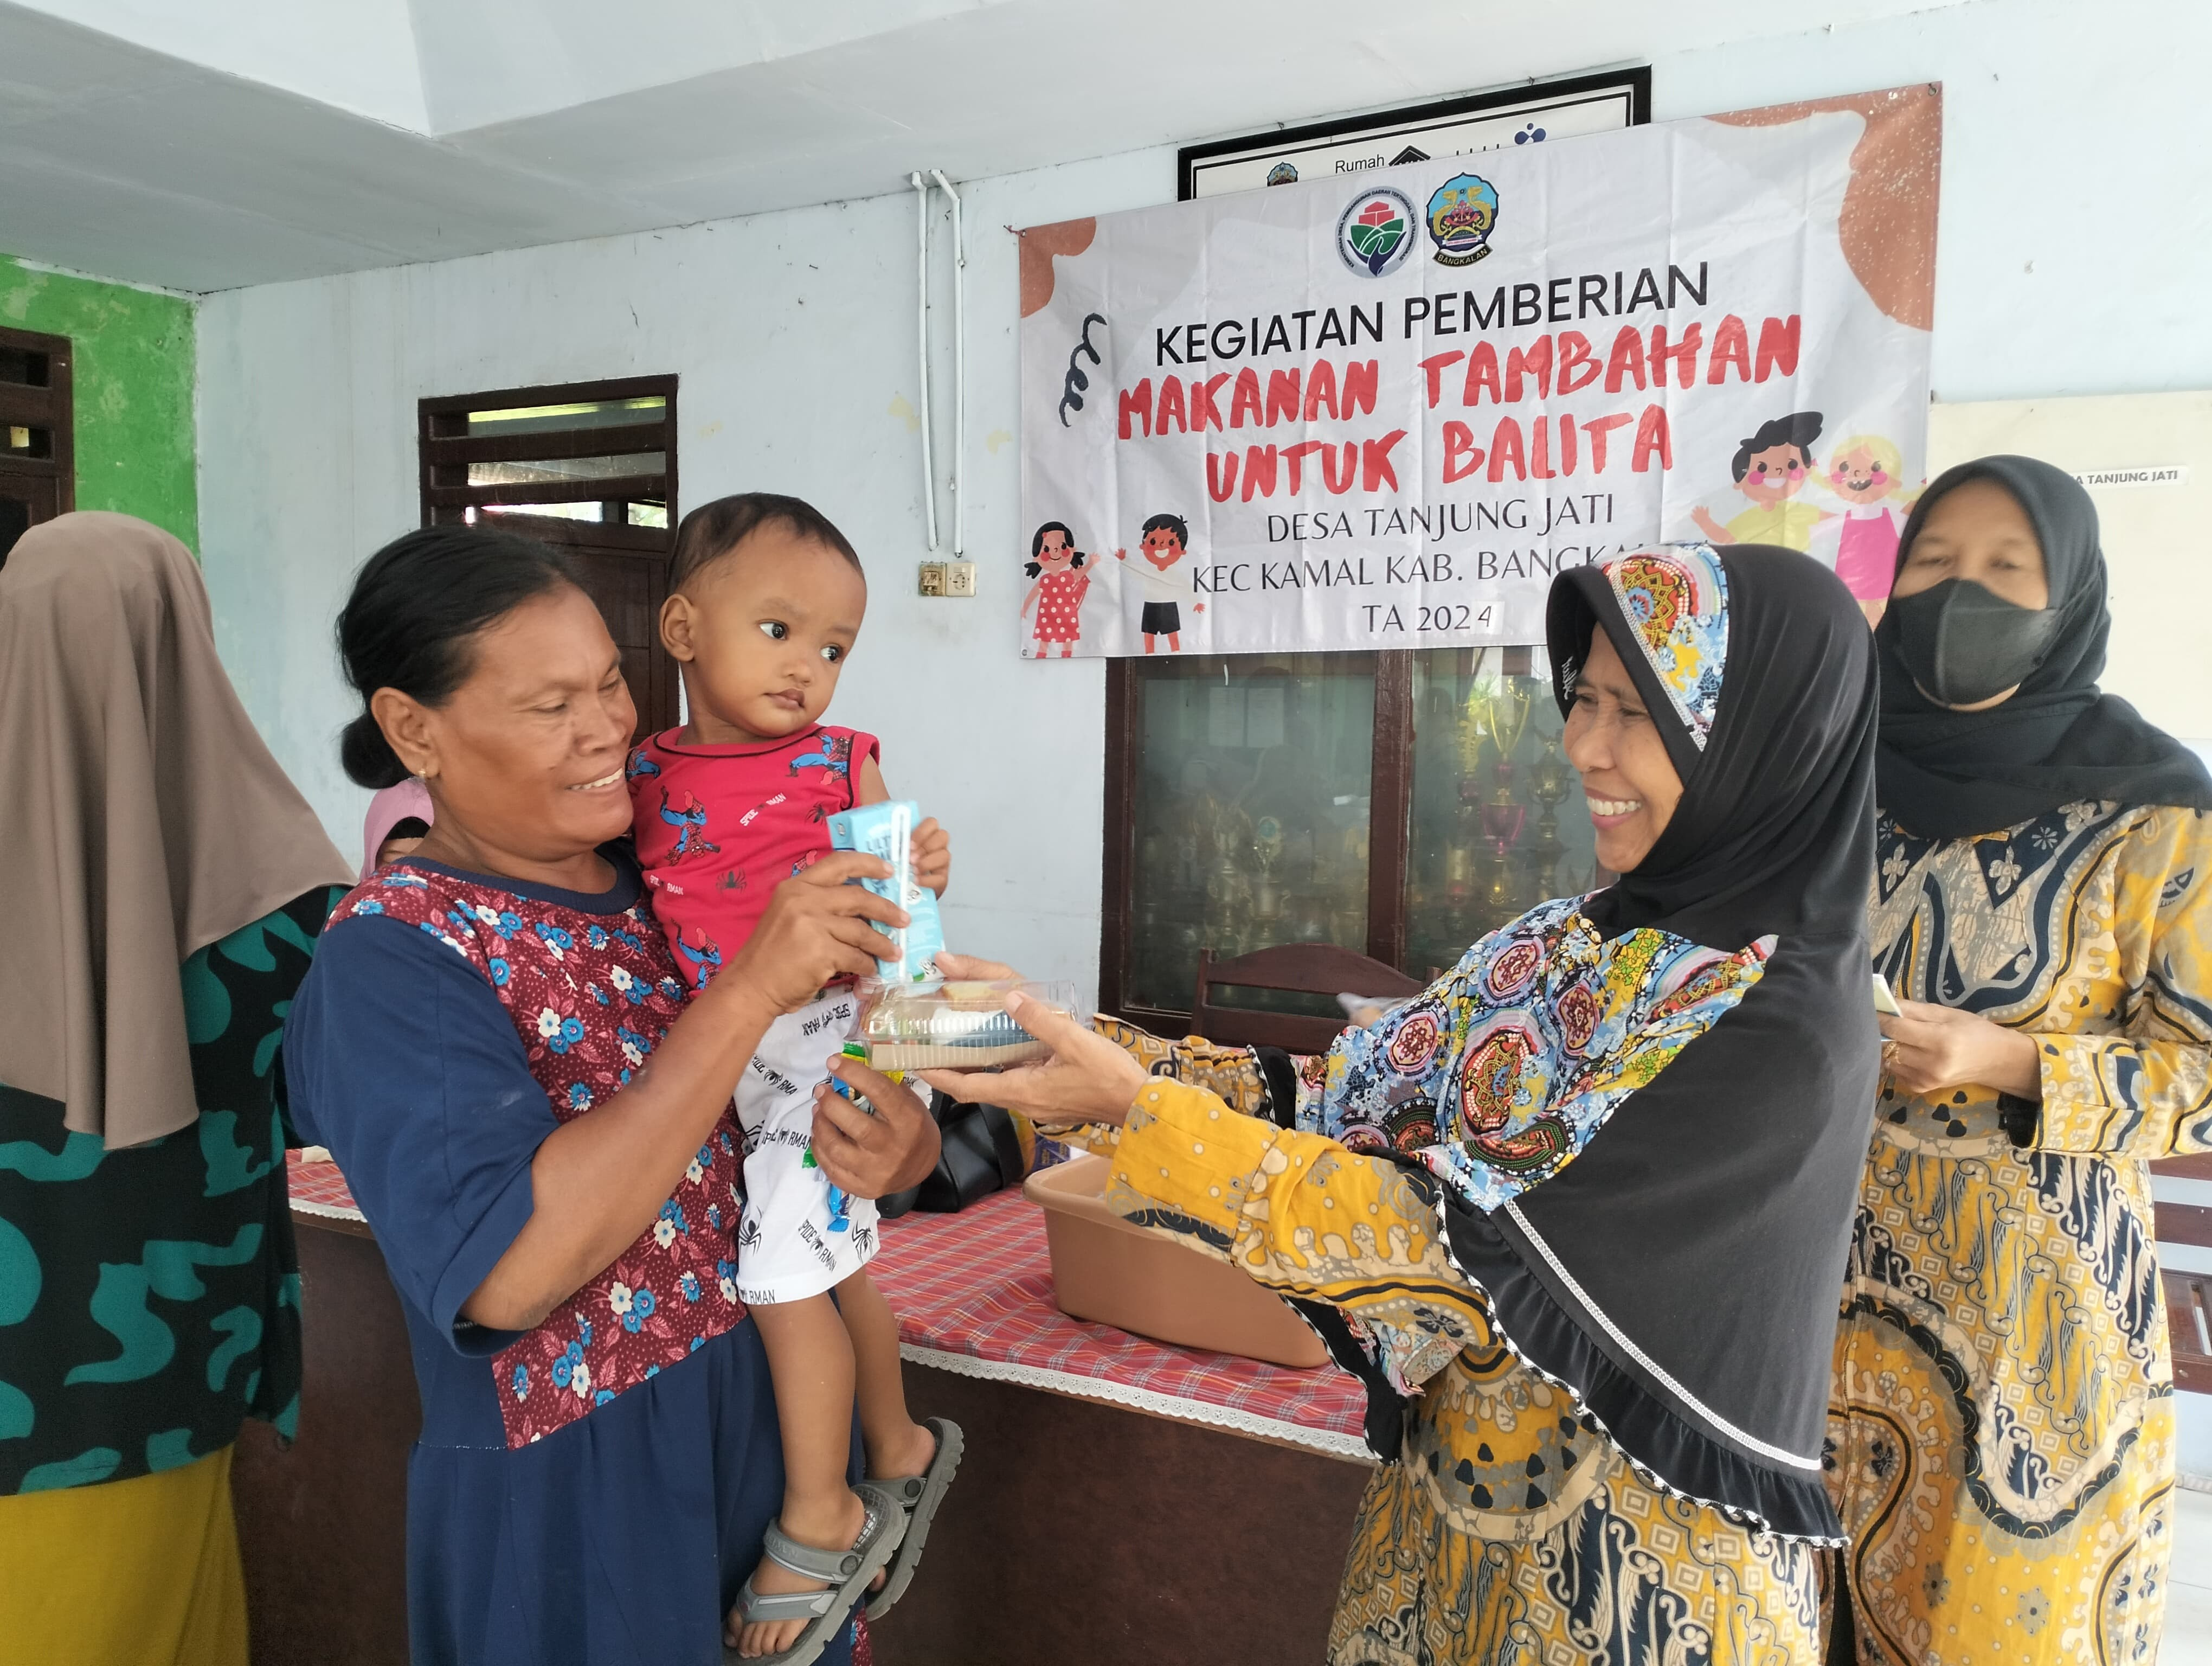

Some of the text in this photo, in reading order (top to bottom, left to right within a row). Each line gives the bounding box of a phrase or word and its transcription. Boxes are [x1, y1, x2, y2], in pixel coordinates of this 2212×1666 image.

[1335, 154, 1384, 174] Rumah
[1437, 248, 1488, 265] BANGKALAN
[1157, 261, 1708, 366] KEGIATAN PEMBERIAN
[1118, 314, 1801, 440] MAKANAN TAMBAHAN
[1206, 403, 1673, 502] UNTUK BALITA
[2087, 472, 2148, 484] TANJUNG
[2152, 470, 2178, 482] JATI
[1268, 493, 1613, 542] DESA TANJUNG JATI
[1193, 563, 1251, 594] KEC
[1261, 557, 1374, 590] KAMAL
[1386, 552, 1463, 584] KAB.
[1362, 605, 1493, 633] TA 2024
[749, 1289, 775, 1304] RMAN
